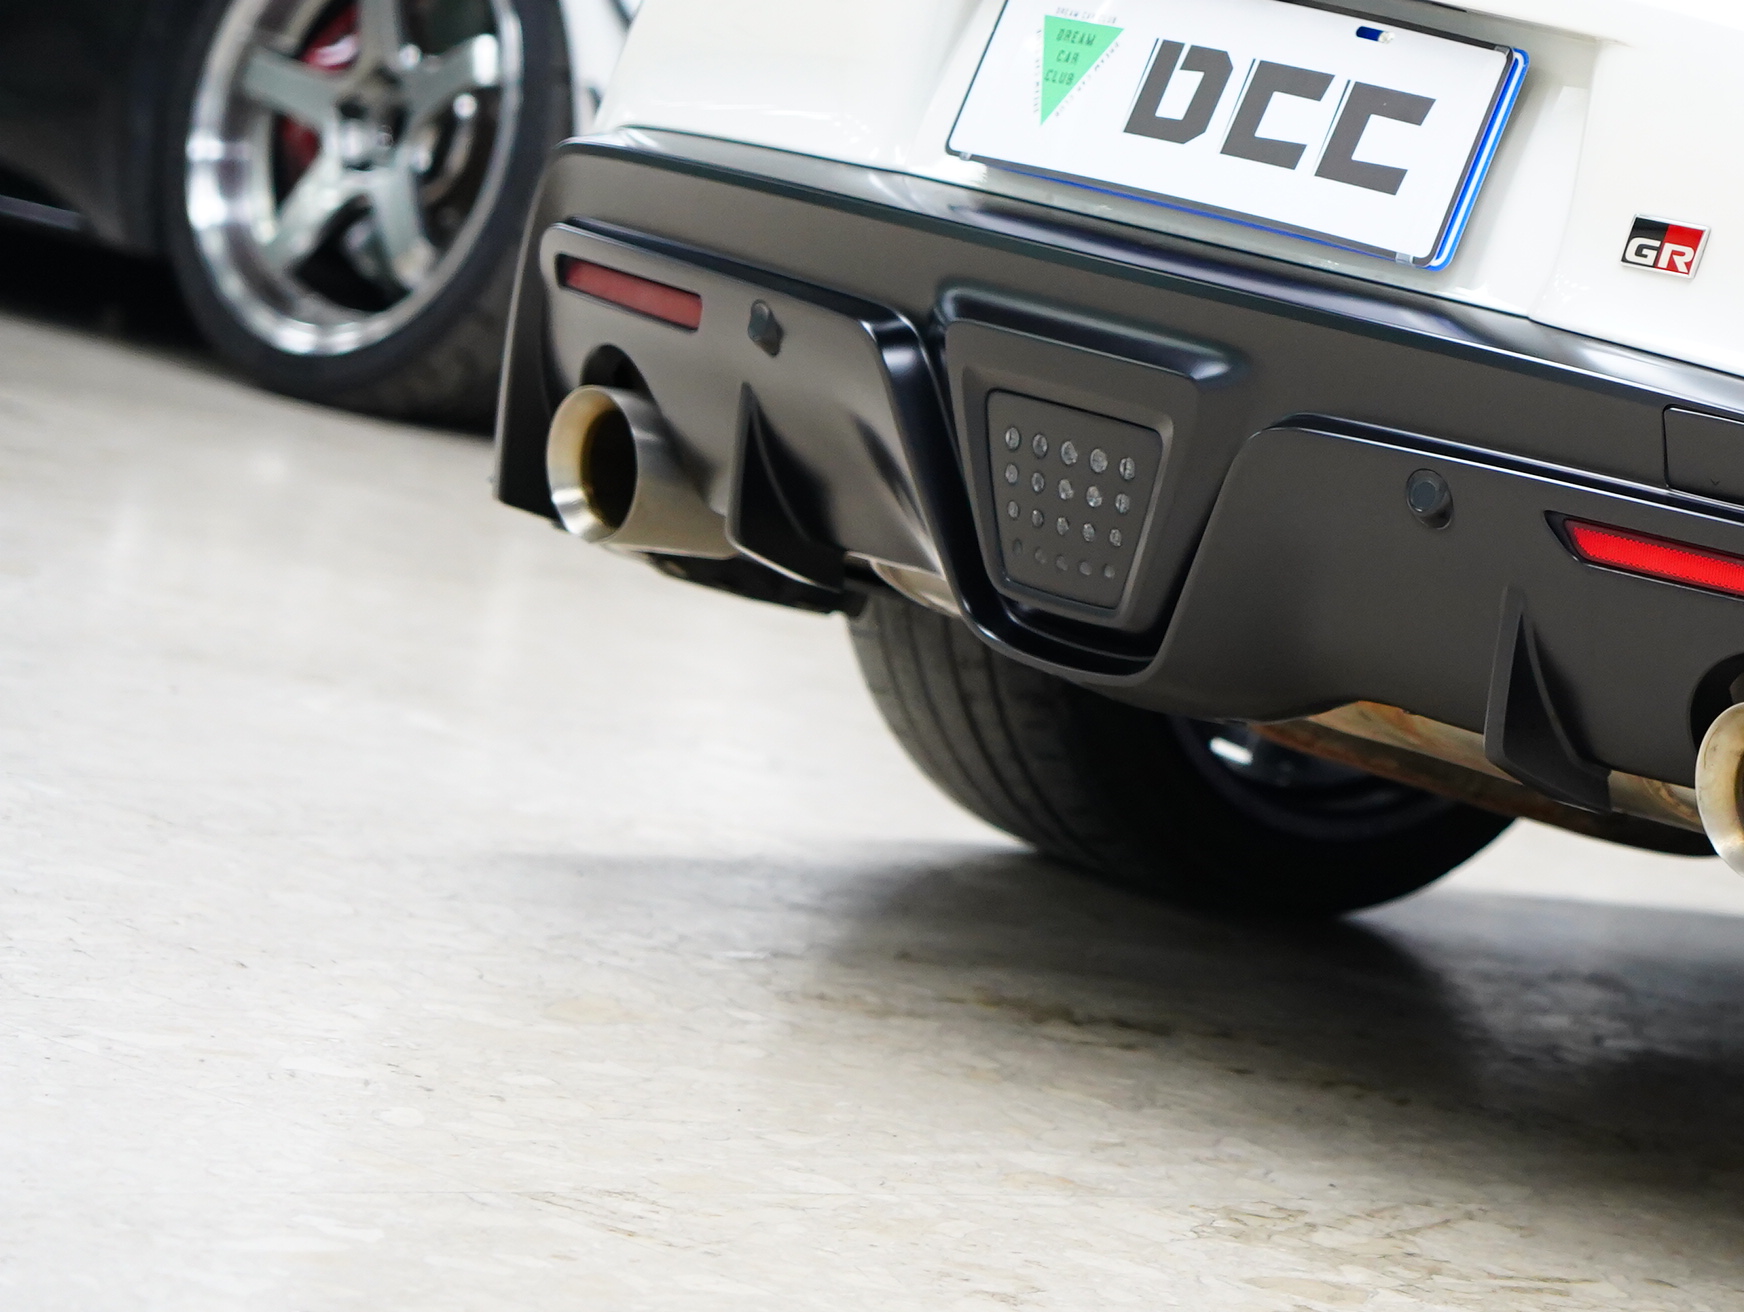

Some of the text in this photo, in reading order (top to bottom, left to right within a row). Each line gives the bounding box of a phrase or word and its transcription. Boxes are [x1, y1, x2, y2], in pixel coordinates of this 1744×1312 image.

[1056, 28, 1096, 46] DREAM
[1056, 49, 1079, 64] CAR
[1044, 69, 1075, 86] CLUB
[1123, 38, 1436, 195] DCC
[1625, 237, 1694, 273] GR
